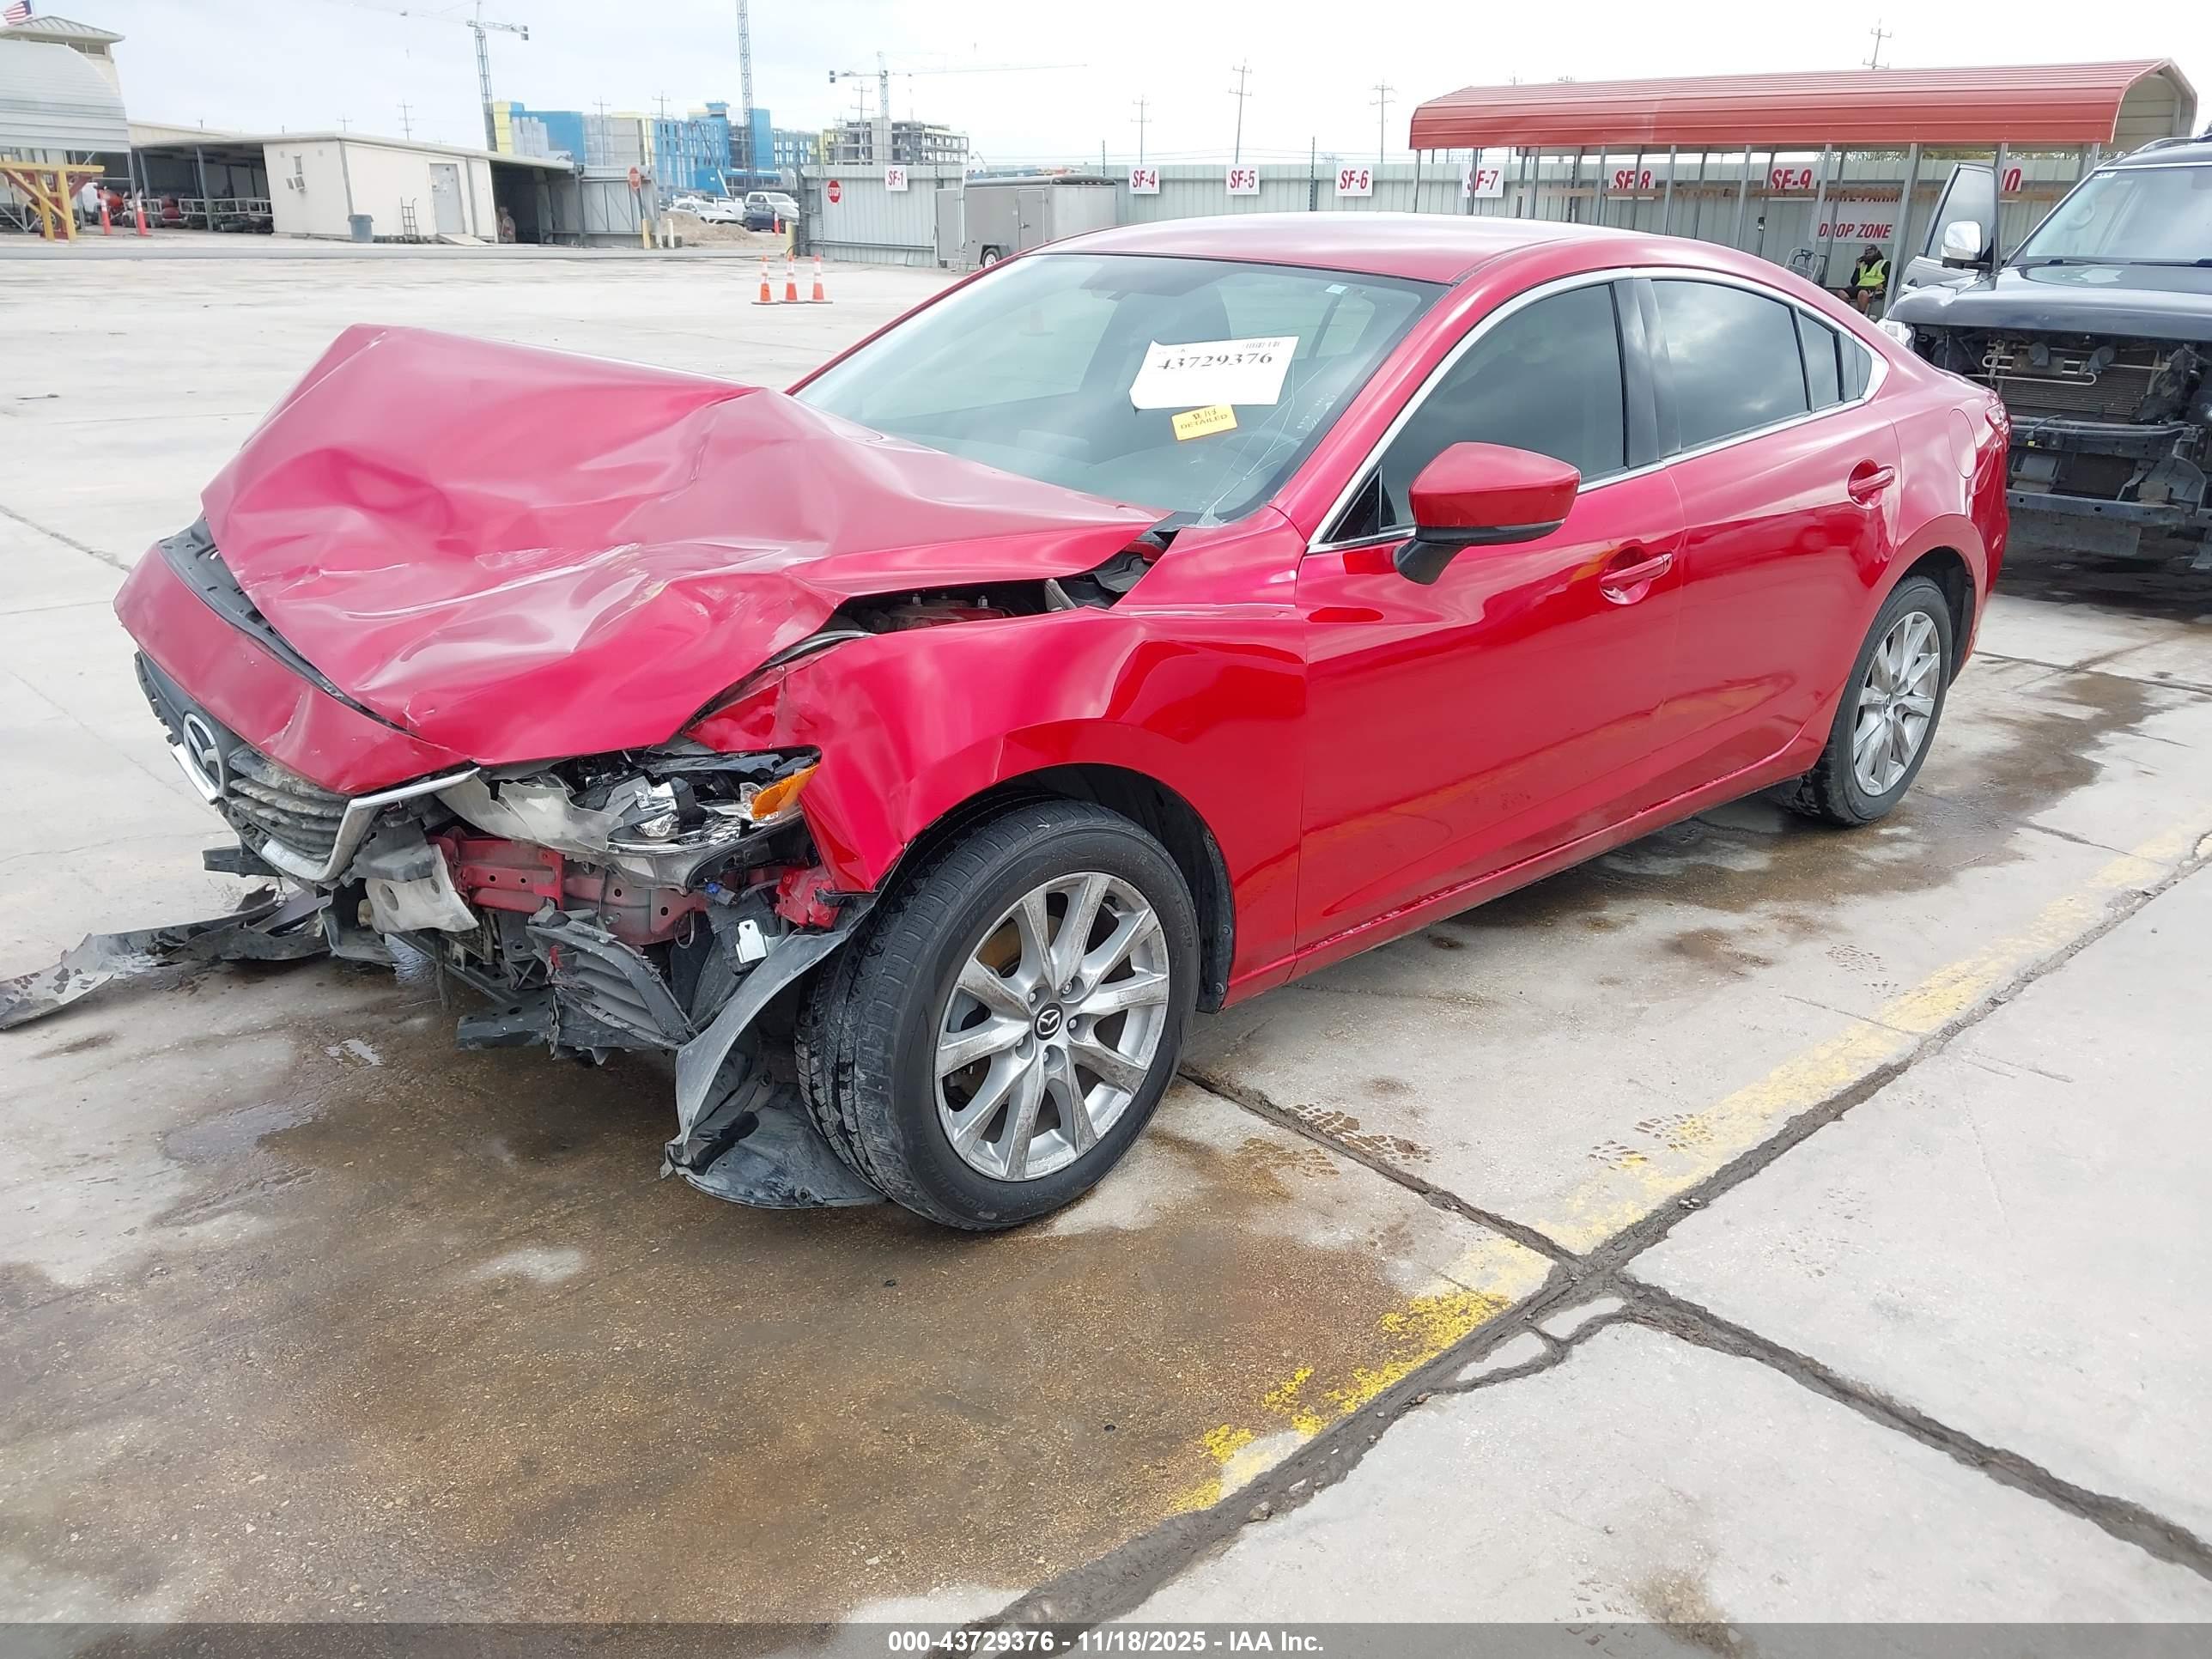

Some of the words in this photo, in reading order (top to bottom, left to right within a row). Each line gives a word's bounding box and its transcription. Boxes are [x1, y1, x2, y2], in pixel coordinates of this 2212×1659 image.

[888, 170, 903, 186] SF-1
[1133, 170, 1156, 188] SF-4
[1230, 169, 1255, 189] SF-5
[1340, 169, 1369, 190] SF-6
[1819, 223, 1855, 237] DOP
[1856, 224, 1893, 239] ZONE
[1158, 353, 1273, 370] 43729376
